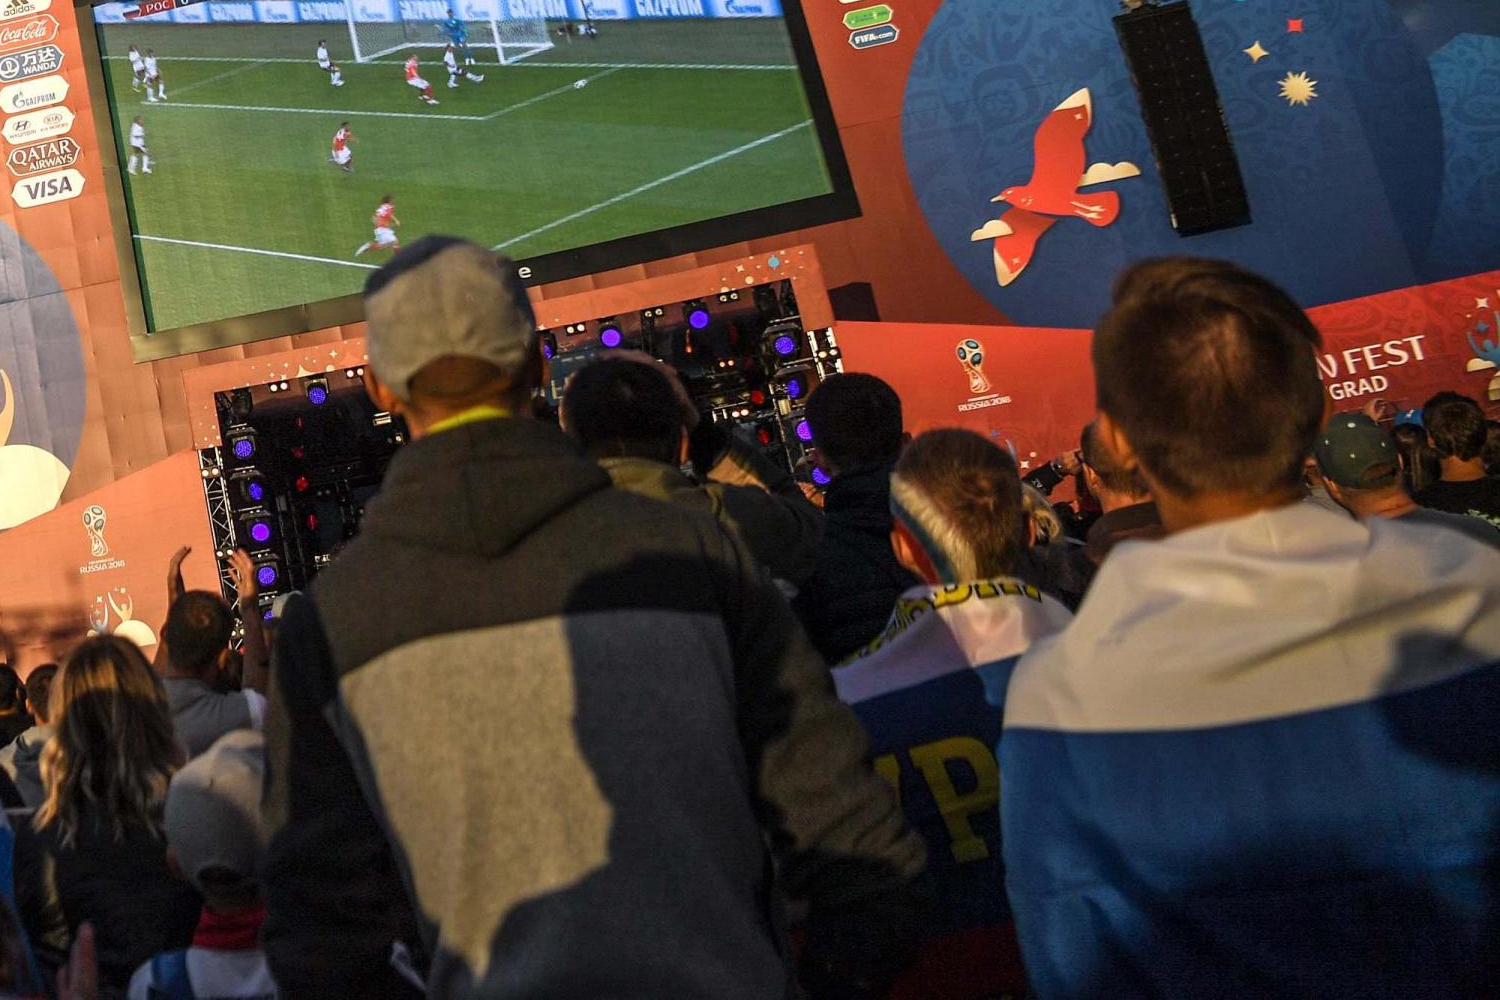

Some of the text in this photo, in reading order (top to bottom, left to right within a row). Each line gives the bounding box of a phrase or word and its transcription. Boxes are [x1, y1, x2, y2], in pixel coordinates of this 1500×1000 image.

[3, 4, 36, 17] adidas
[146, 0, 169, 14] РОС
[20, 48, 56, 67] 万达
[23, 61, 57, 75] WANDA
[25, 92, 56, 106] GAZPROM
[12, 140, 71, 166] QATAR
[29, 153, 73, 171] AIRWAYS
[22, 176, 72, 200] VISA
[1343, 335, 1425, 375] FEST
[1328, 375, 1388, 400] GRAD
[957, 400, 990, 412] RUSSIA
[79, 563, 107, 574] RUSSIA
[107, 559, 125, 569] 2018
